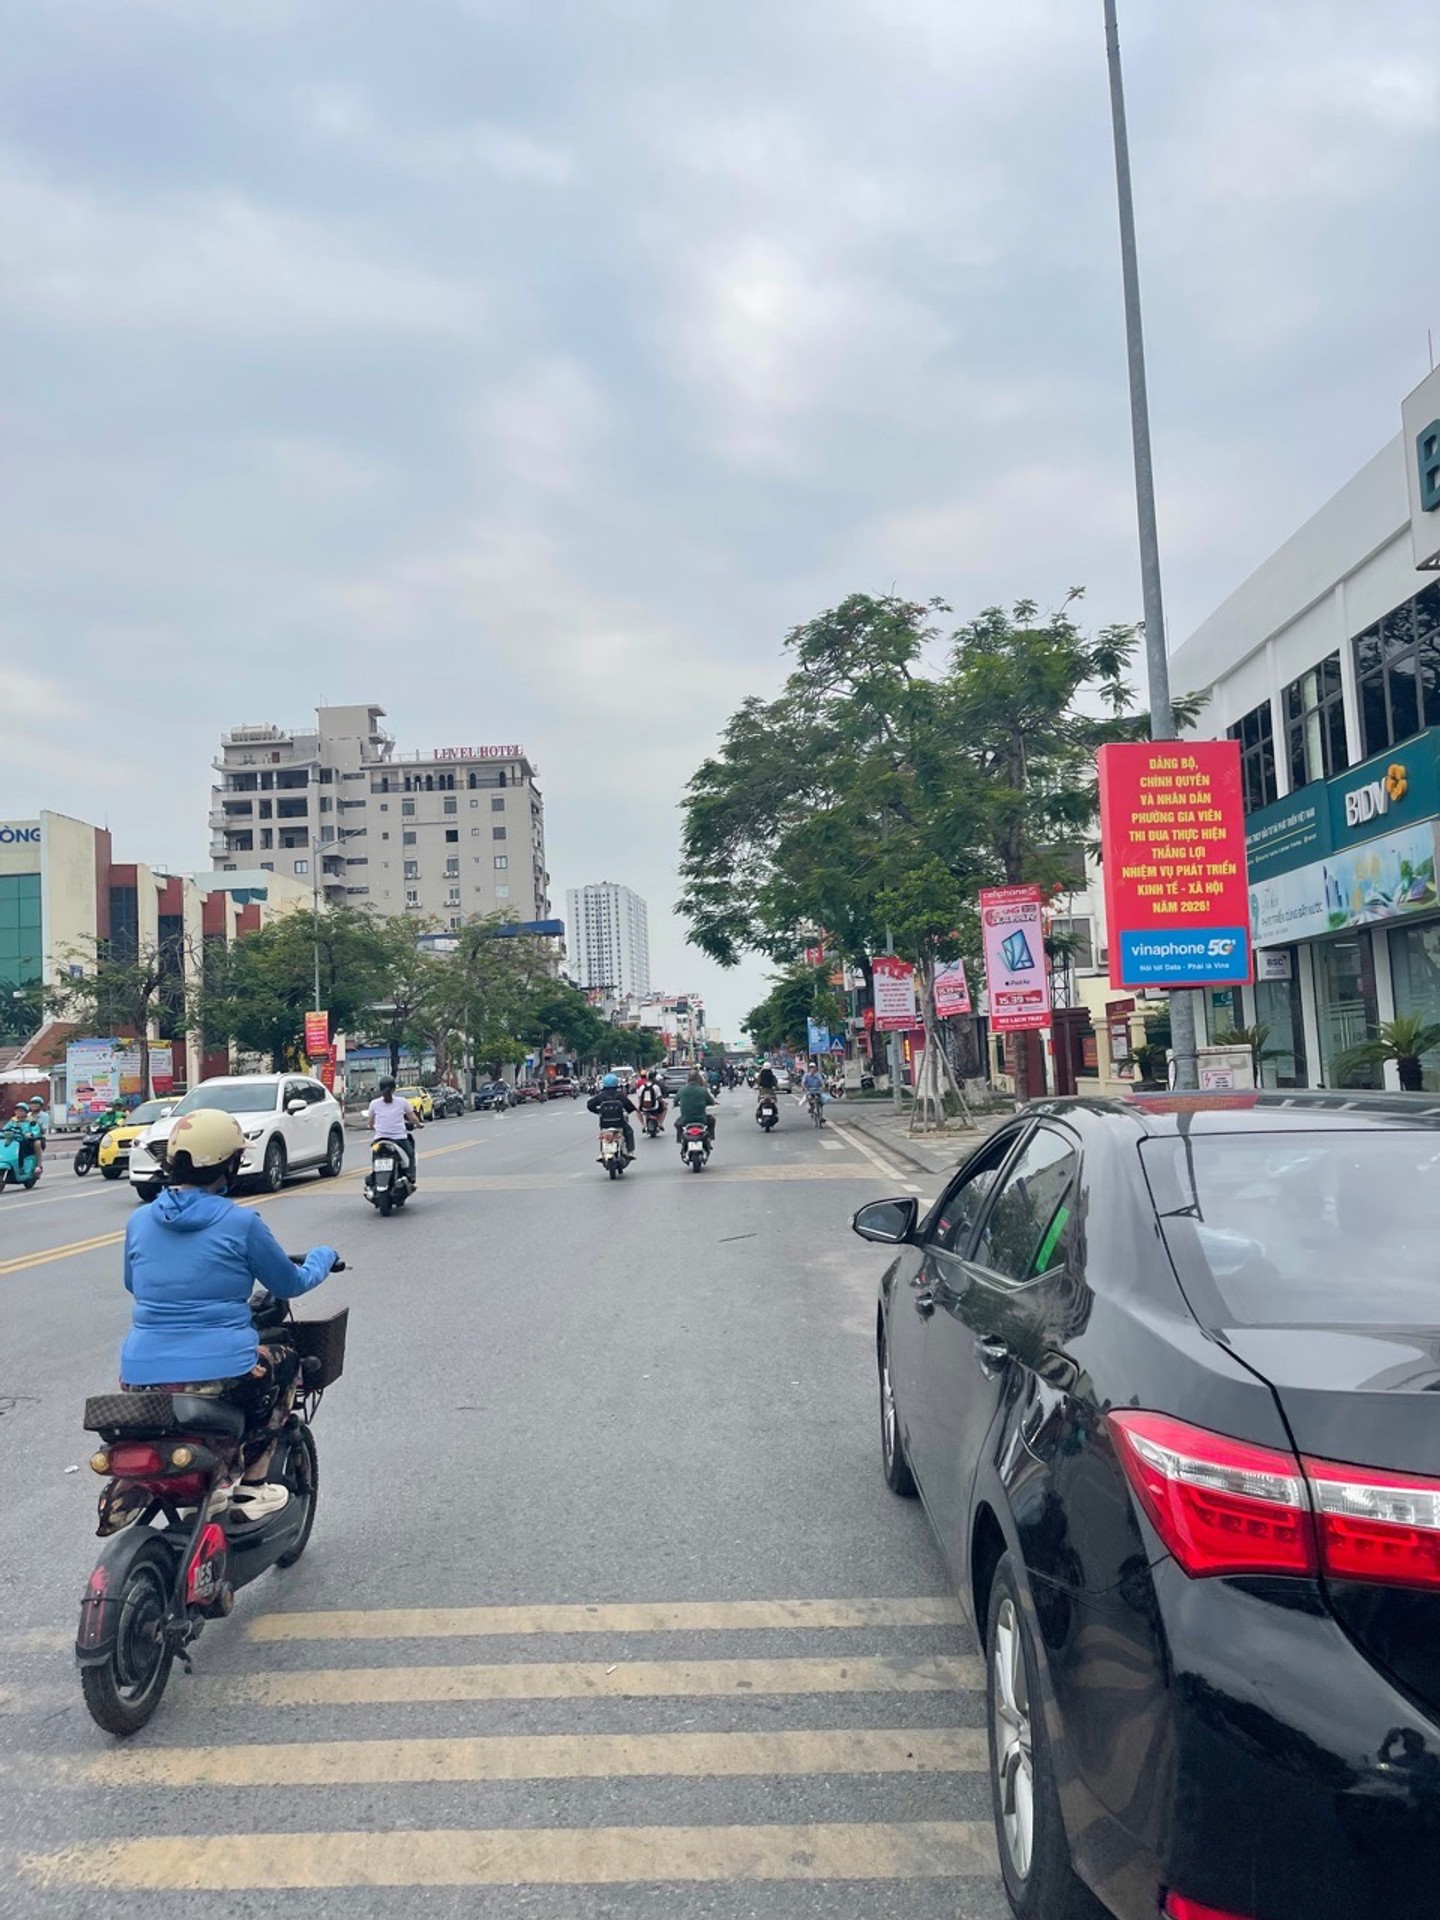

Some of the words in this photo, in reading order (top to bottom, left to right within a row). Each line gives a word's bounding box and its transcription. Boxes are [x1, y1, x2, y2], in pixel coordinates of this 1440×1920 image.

[478, 744, 524, 759] HOTEL
[1149, 755, 1178, 769] ĐẢNG
[1181, 755, 1199, 771] BỘ,
[1140, 774, 1172, 788] CHÍNH
[1175, 772, 1210, 788] QUYỀN
[1140, 792, 1154, 805] VÀ
[1157, 791, 1186, 805] NHÂN
[1189, 791, 1211, 804] DÂN
[1345, 776, 1388, 827] BIDV
[1131, 809, 1175, 824] PHƯỜNG
[1177, 811, 1195, 822] GIA
[1198, 808, 1222, 822] VIÊN
[1129, 830, 1146, 842] THI
[1148, 829, 1169, 841] ĐUA
[1171, 828, 1199, 843] THỰC
[1201, 826, 1226, 841] HIỆN
[1151, 844, 1186, 859] THẮNG
[1189, 845, 1206, 860] LỢI
[1122, 864, 1157, 880] NHIỆM
[1159, 865, 1174, 878] VỤ
[1176, 863, 1203, 876] PHÁT
[1206, 860, 1237, 875] TRIỂN
[1137, 883, 1163, 896] KINH
[1166, 880, 1178, 895] TẾ
[1188, 881, 1203, 894] XÃ
[1205, 880, 1224, 895] HỘI
[1153, 900, 1178, 913] NĂM
[1181, 900, 1210, 912] 2026!
[1131, 942, 1205, 958] vinaphone
[1207, 939, 1236, 956] 5G
